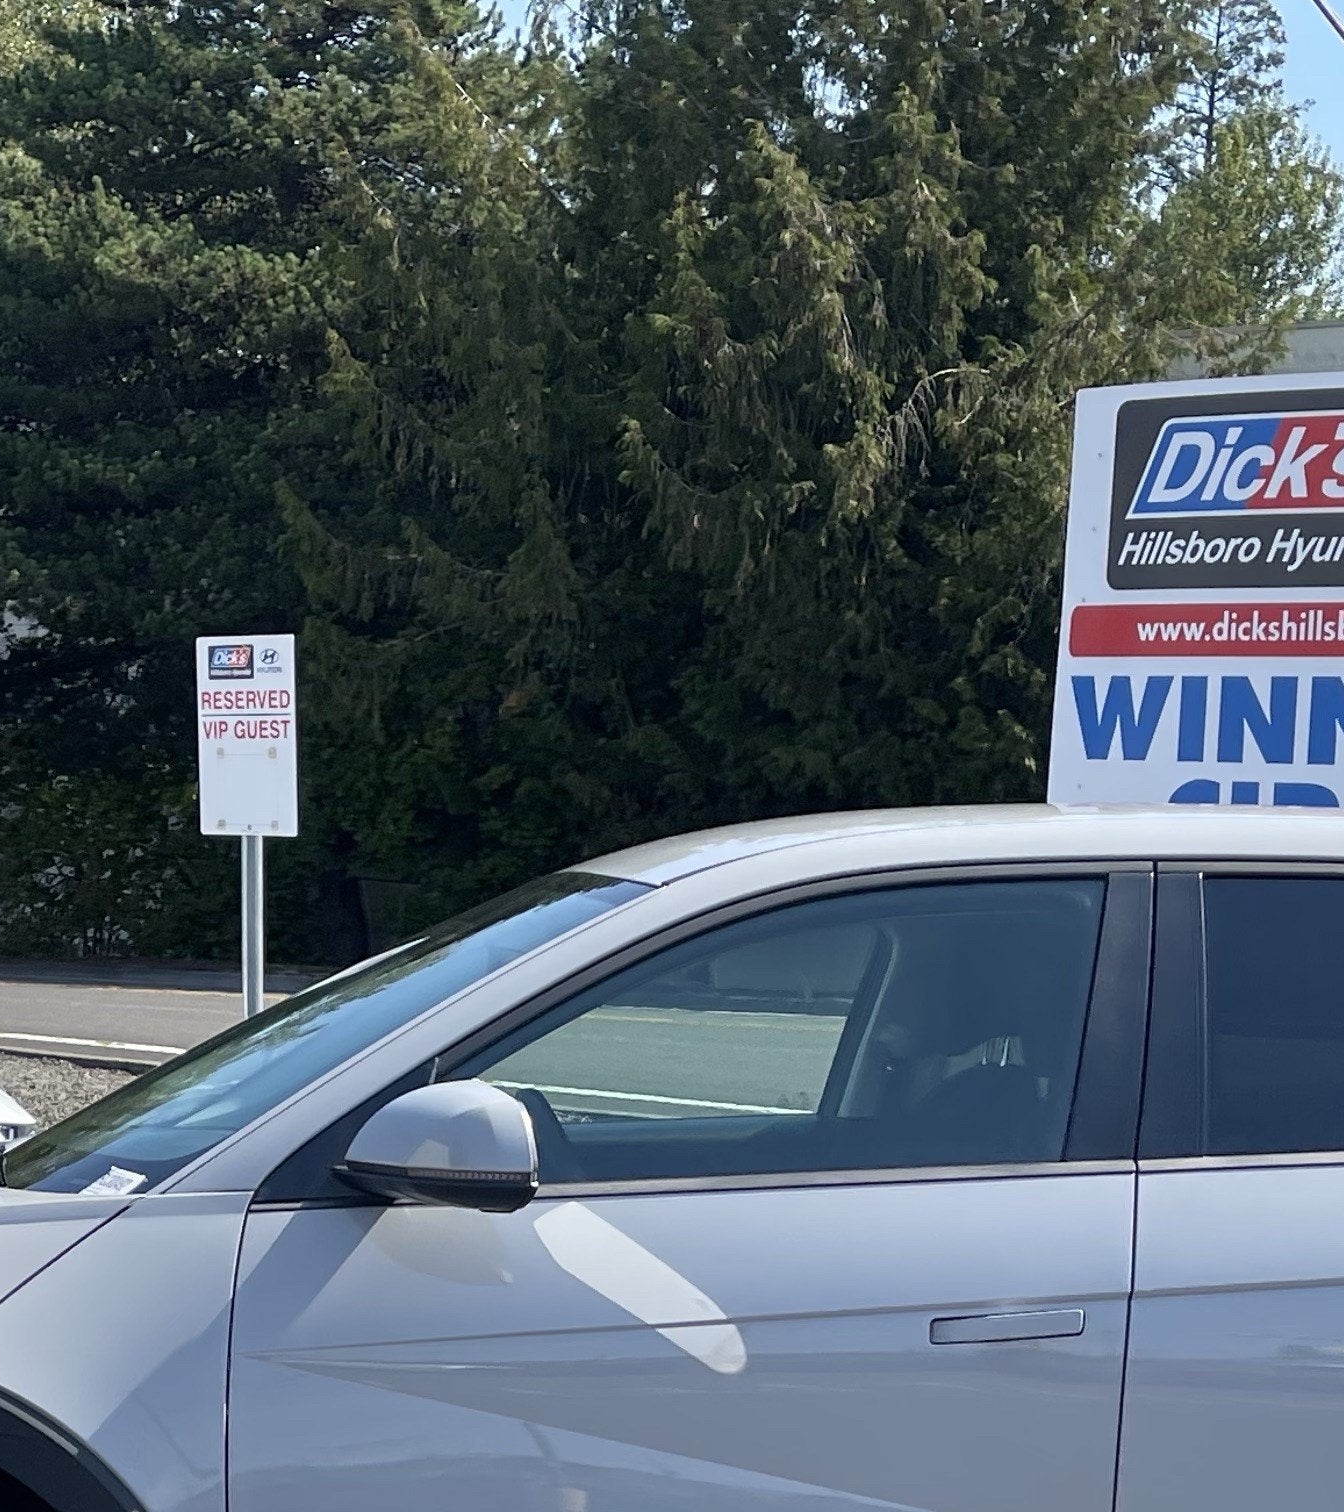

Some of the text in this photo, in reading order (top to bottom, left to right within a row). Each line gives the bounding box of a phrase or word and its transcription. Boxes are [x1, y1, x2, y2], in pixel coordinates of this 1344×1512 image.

[1117, 529, 1261, 566] Hillsboro
[201, 690, 291, 710] RESERVED
[202, 720, 291, 740] VIP GUEST
